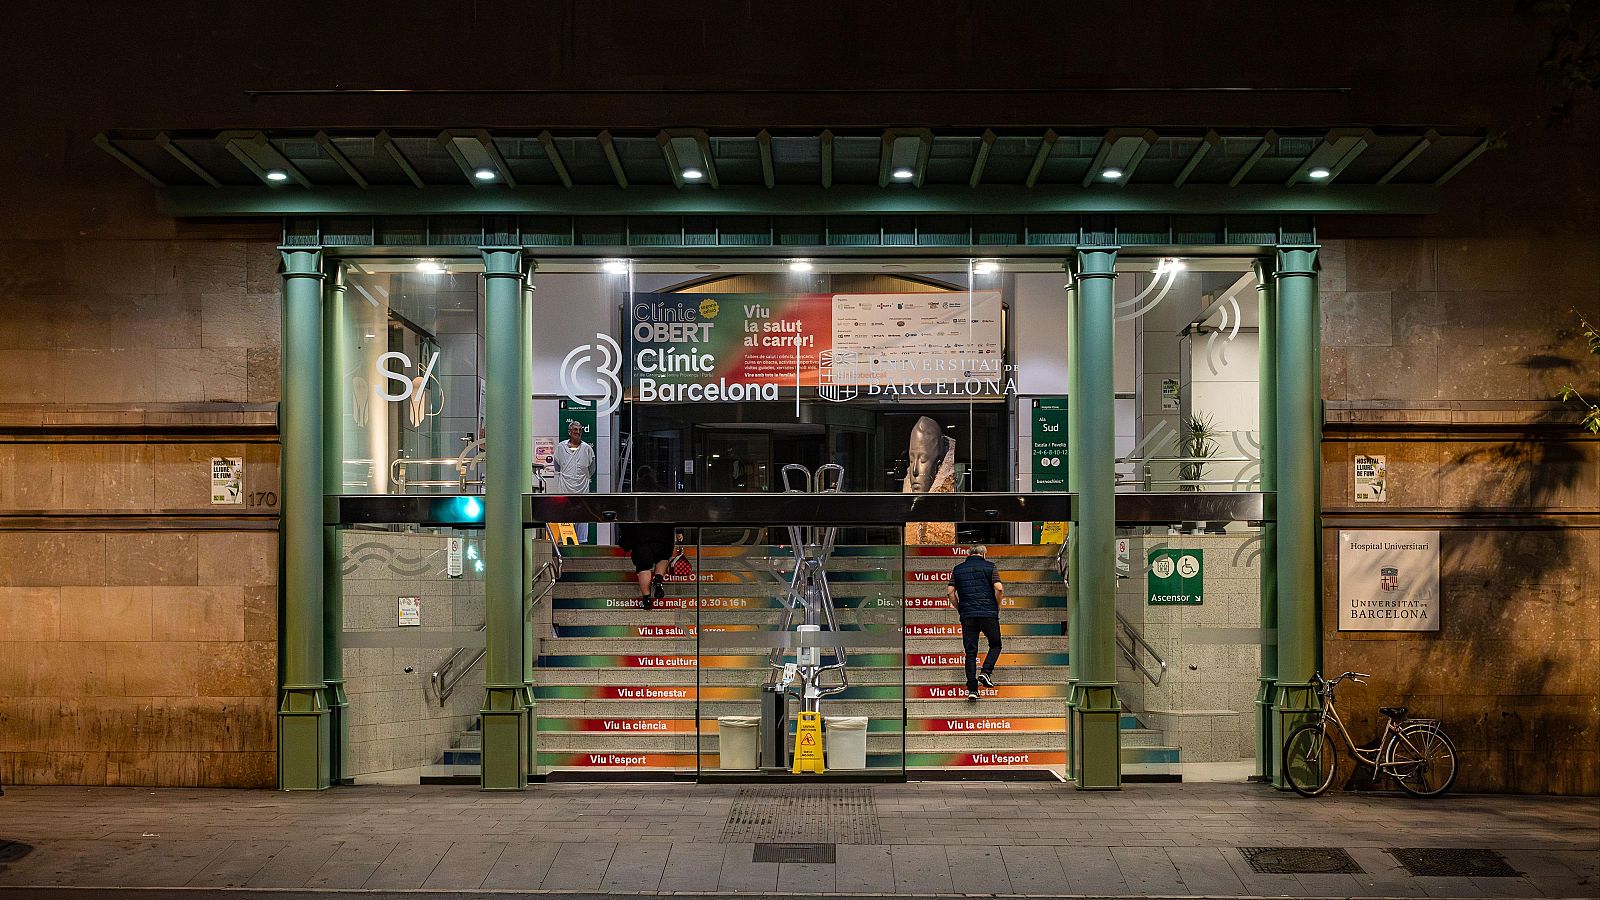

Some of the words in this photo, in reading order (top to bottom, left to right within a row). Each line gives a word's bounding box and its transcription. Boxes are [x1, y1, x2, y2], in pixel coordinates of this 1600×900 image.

[634, 302, 697, 322] Clínic
[743, 304, 770, 319] Viu
[744, 319, 759, 333] la
[763, 319, 802, 333] salut
[633, 322, 714, 343] OBERT
[743, 333, 759, 347] al
[762, 334, 814, 347] carrer!
[637, 346, 715, 373] Clínic
[869, 356, 1002, 373] UNIVERSITAT
[639, 377, 779, 402] Barcelona
[867, 377, 1018, 395] BARCELONA
[1042, 423, 1059, 432] Sud
[248, 491, 278, 507] 170
[1350, 542, 1383, 551] Hospital
[1384, 542, 1429, 550] Universitari
[914, 573, 929, 581] Viu
[930, 573, 939, 581] el
[914, 598, 921, 607] 9
[922, 598, 933, 607] de
[1008, 597, 1015, 606] h
[1151, 593, 1190, 602] Ascensor
[652, 598, 664, 607] de
[665, 598, 687, 609] maig
[701, 598, 721, 607] 9.30
[722, 599, 728, 607] a
[729, 598, 739, 607] 16
[741, 598, 747, 607] h
[1351, 599, 1419, 608] UNIVERSITAT
[1351, 609, 1428, 619] BARCELONA
[638, 626, 653, 635] Viu
[655, 626, 664, 635] la
[913, 625, 923, 634] la
[923, 625, 945, 634] salut
[947, 625, 956, 634] al
[638, 656, 654, 666] Viu
[655, 657, 665, 666] la
[665, 657, 698, 666] cultura
[920, 655, 936, 664] Viu
[938, 655, 947, 664] la
[617, 688, 634, 697] Viu
[635, 688, 644, 697] el
[646, 688, 687, 697] benestar
[929, 687, 946, 697] Viu
[947, 687, 956, 697] el
[603, 720, 620, 730] Viu
[622, 720, 631, 730] la
[632, 720, 667, 730] ciència
[947, 720, 963, 730] Viu
[965, 720, 974, 729] la
[976, 719, 1011, 729] ciència
[590, 754, 607, 764] Viu
[609, 754, 647, 766] l'esport
[972, 754, 989, 764] Viu
[991, 754, 1029, 765] l'esport
